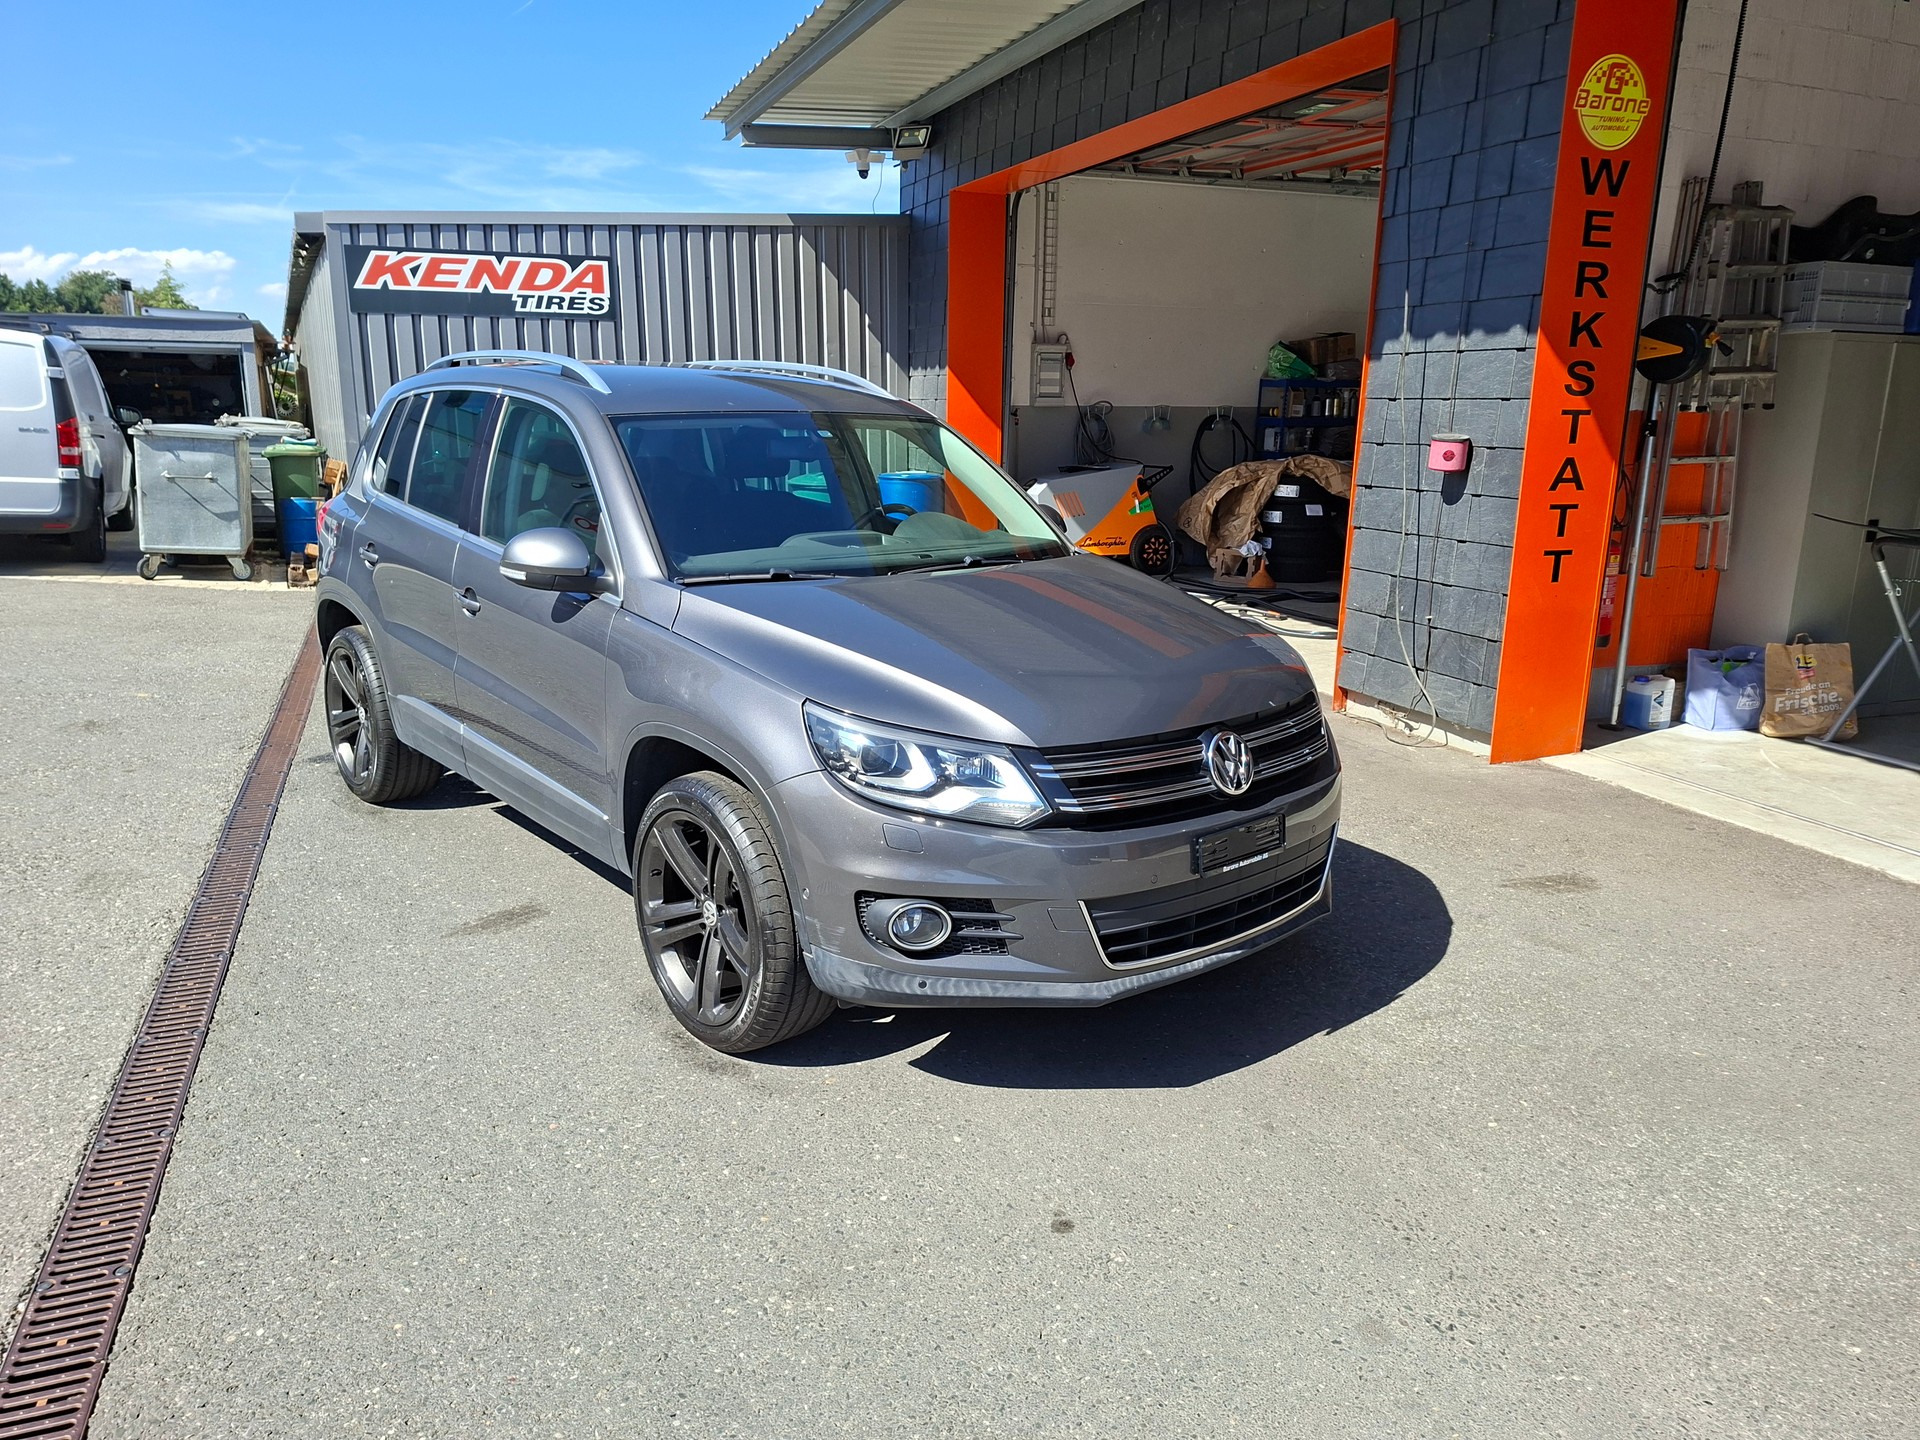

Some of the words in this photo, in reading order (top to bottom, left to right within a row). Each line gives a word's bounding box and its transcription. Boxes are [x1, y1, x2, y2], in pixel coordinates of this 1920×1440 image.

[1575, 88, 1650, 114] Barone
[1591, 124, 1631, 132] AUTOMOBILE
[356, 251, 608, 294] KENDA
[513, 293, 609, 314] TIRES
[1542, 155, 1631, 584] WERKSTATT
[1079, 536, 1128, 549] Lamborghini
[1785, 683, 1817, 695] Freude
[1774, 690, 1843, 713] Frische.
